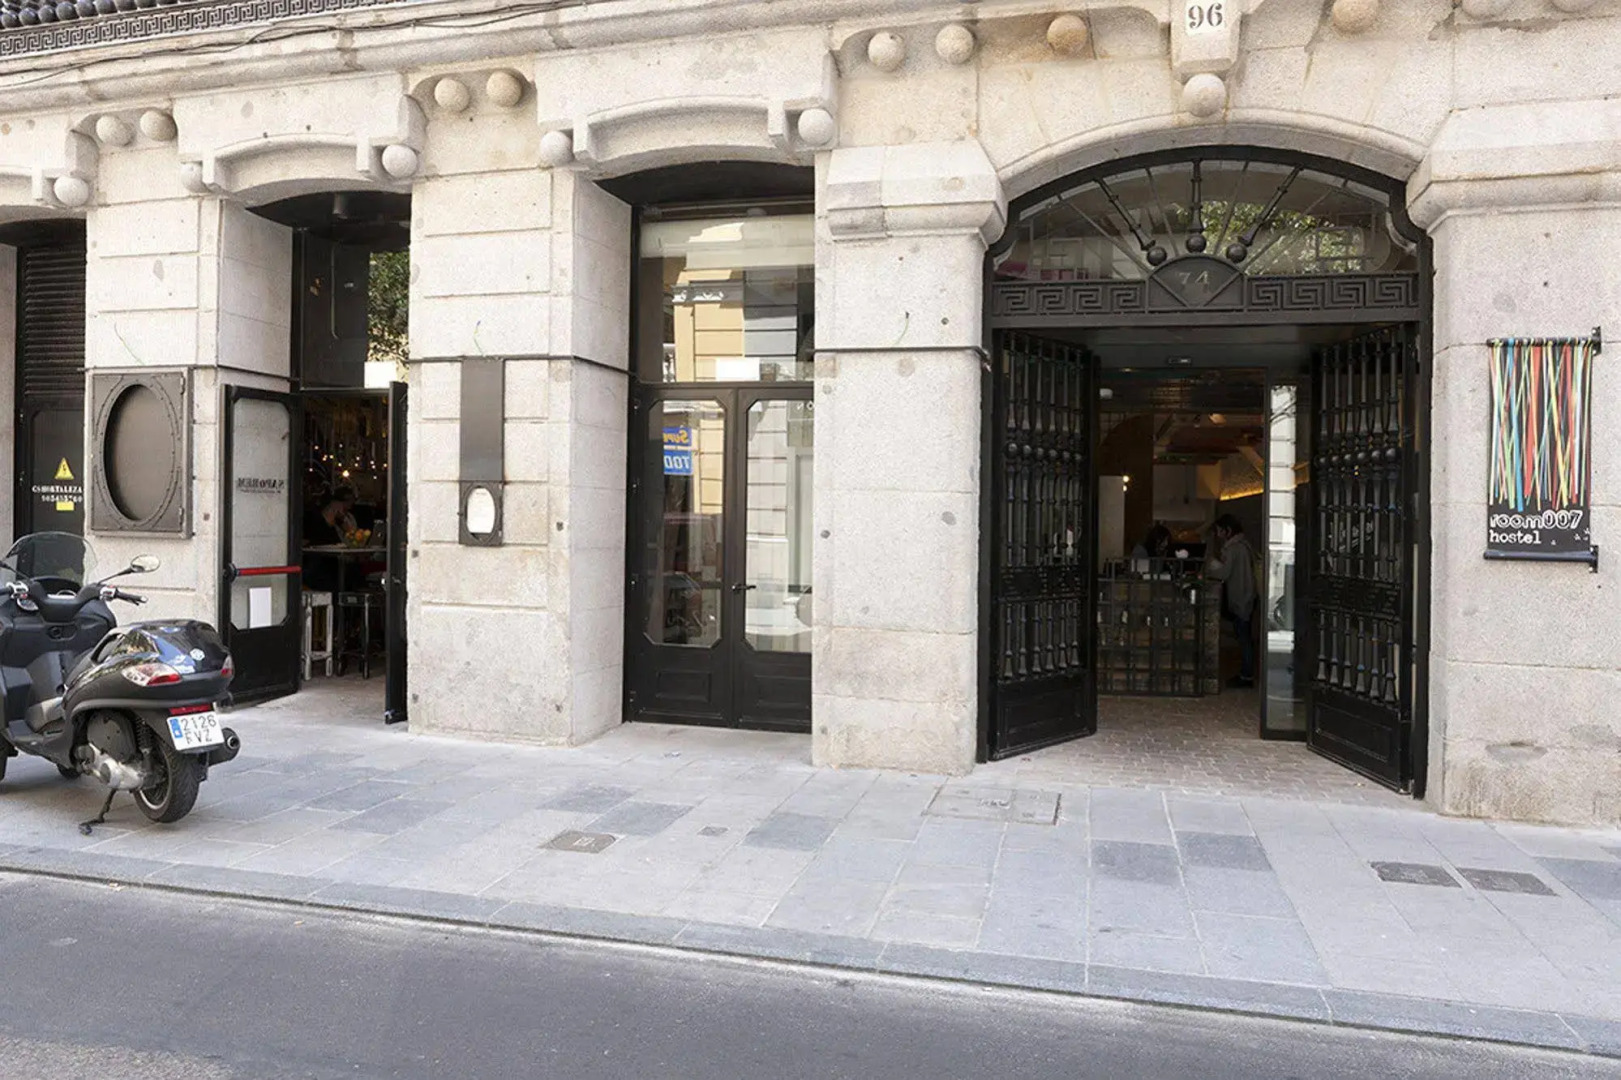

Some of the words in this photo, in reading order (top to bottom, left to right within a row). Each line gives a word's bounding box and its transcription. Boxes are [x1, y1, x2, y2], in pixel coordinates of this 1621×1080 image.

[1188, 3, 1223, 29] 96
[1489, 510, 1583, 529] room007
[1489, 529, 1541, 544] hostel
[180, 714, 217, 731] 2126
